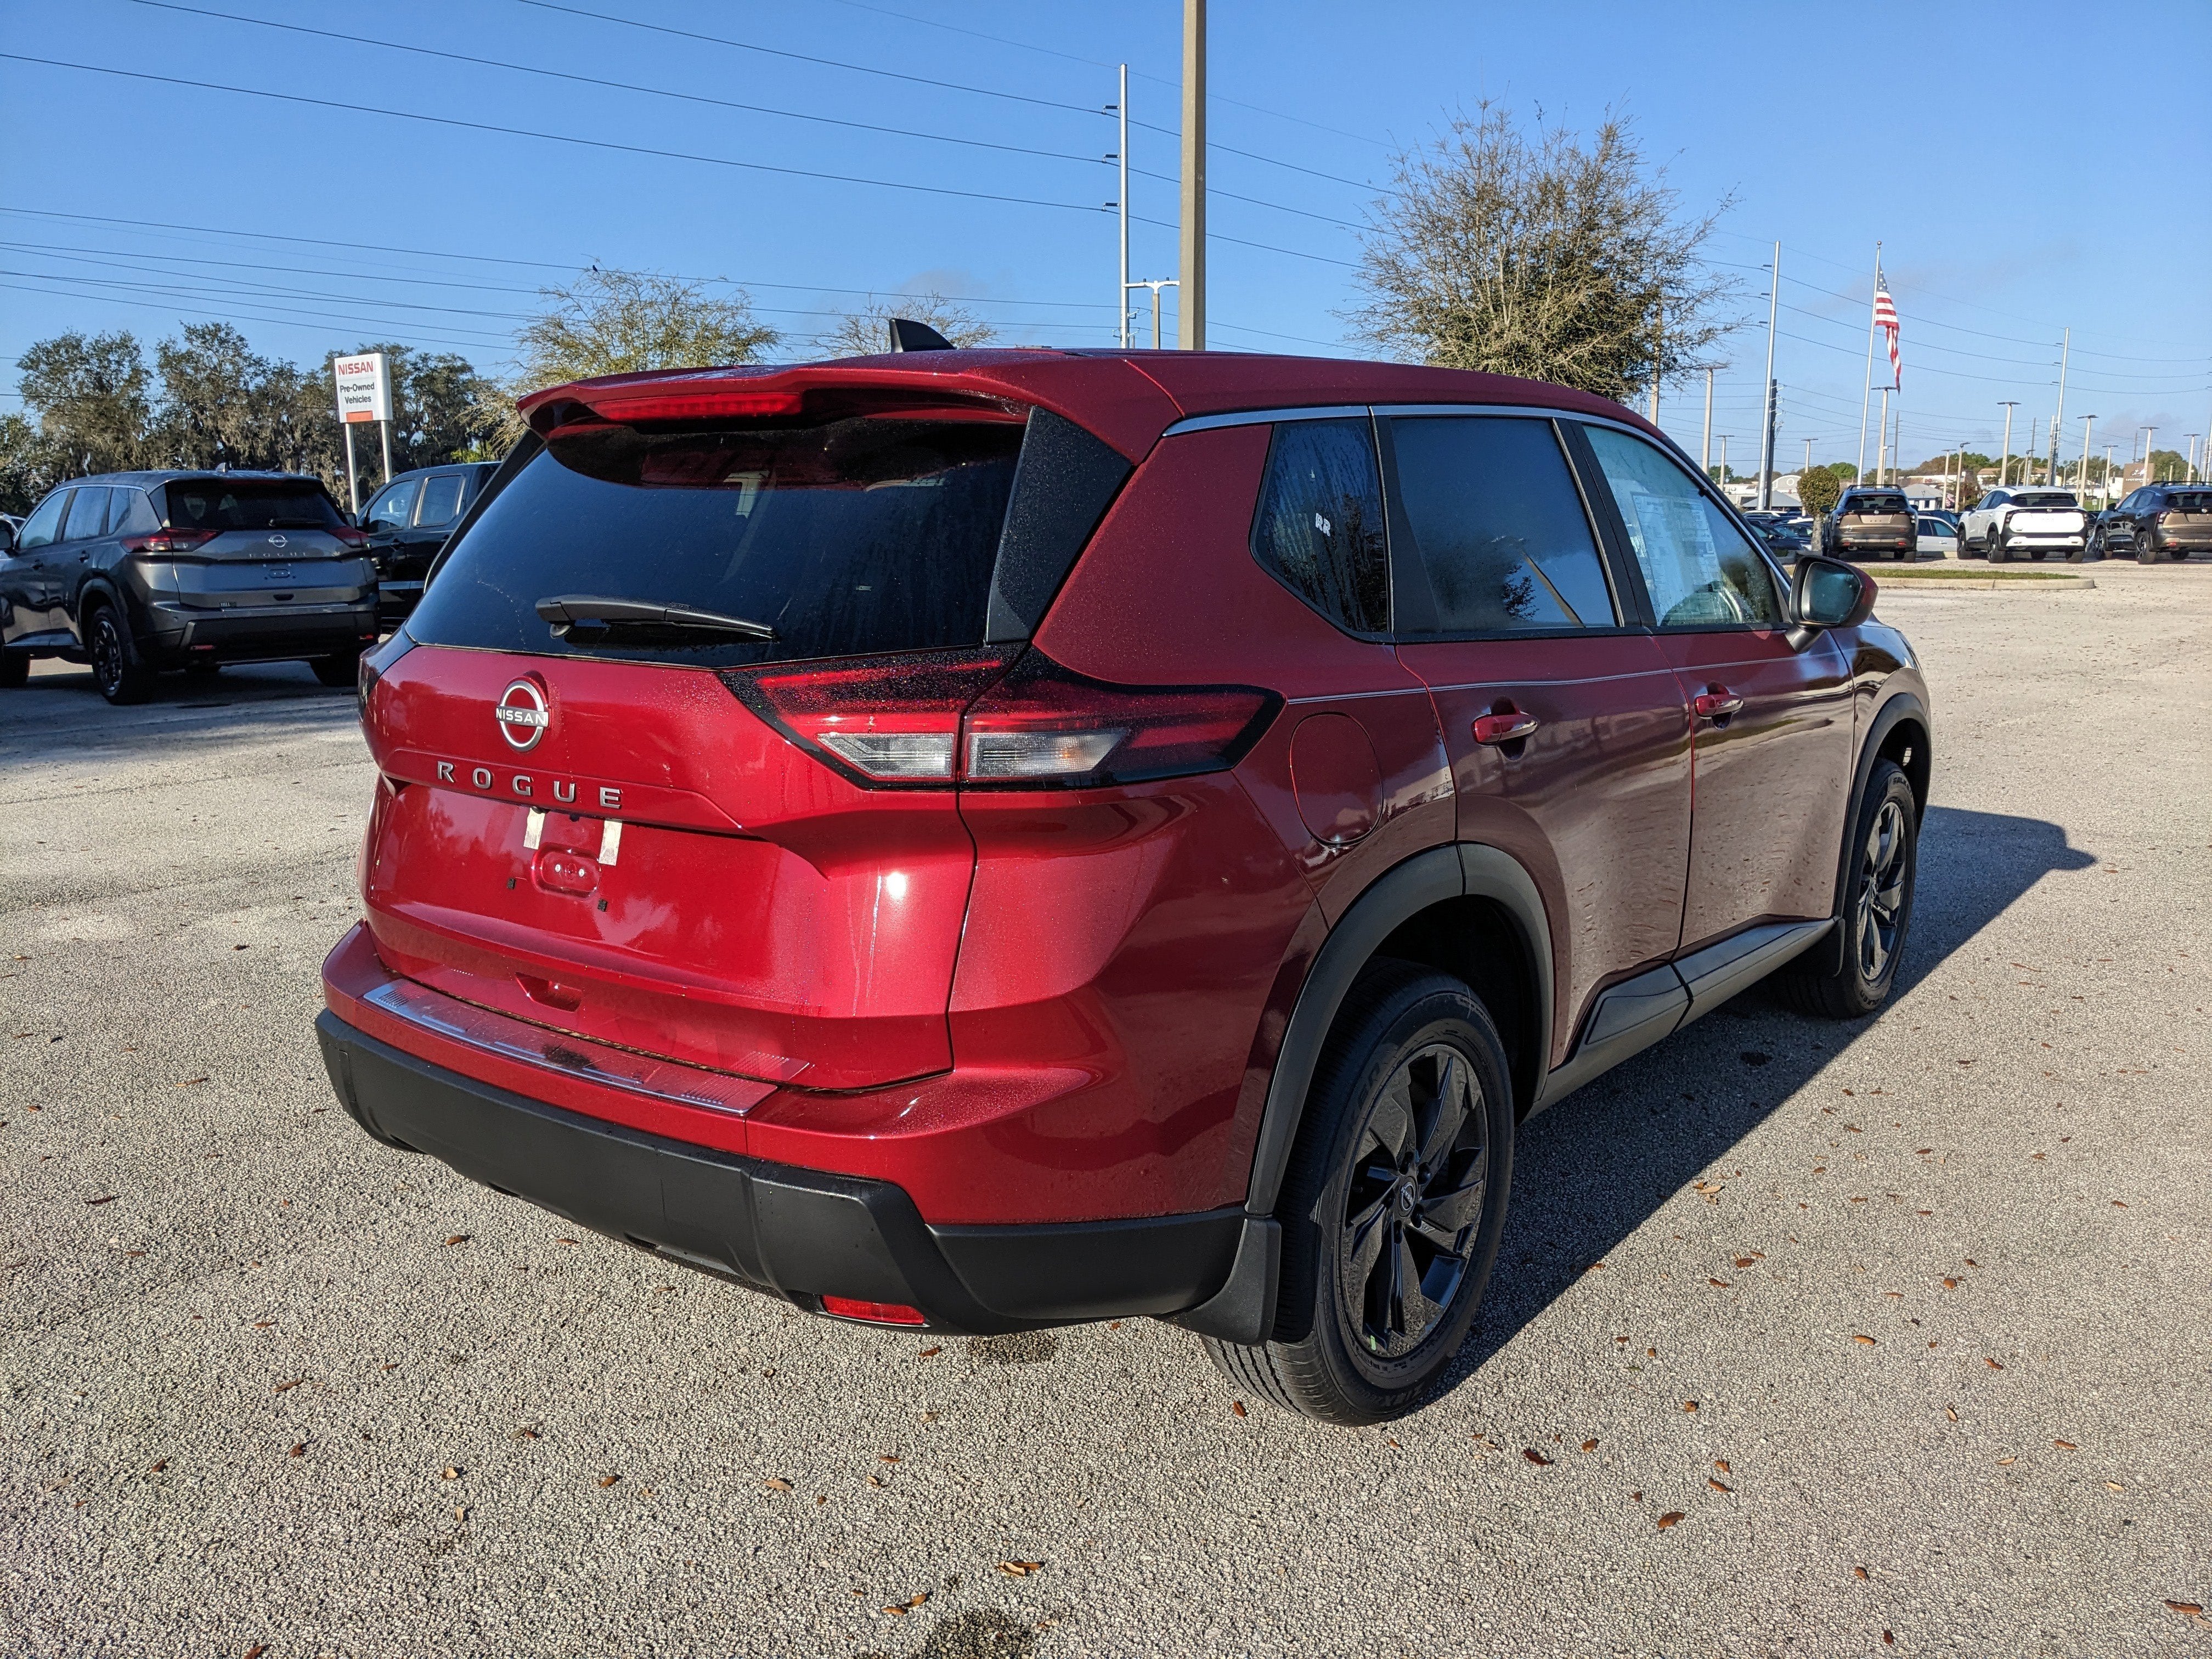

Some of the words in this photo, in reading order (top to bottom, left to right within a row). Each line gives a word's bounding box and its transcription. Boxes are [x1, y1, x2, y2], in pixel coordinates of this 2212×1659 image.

[338, 361, 374, 375] NISSAN
[340, 382, 375, 393] Pre-Owned
[345, 395, 371, 404] Vehicles
[1316, 513, 1330, 537] RR
[496, 708, 546, 725] NISSAN
[437, 761, 623, 809] ROGUE
